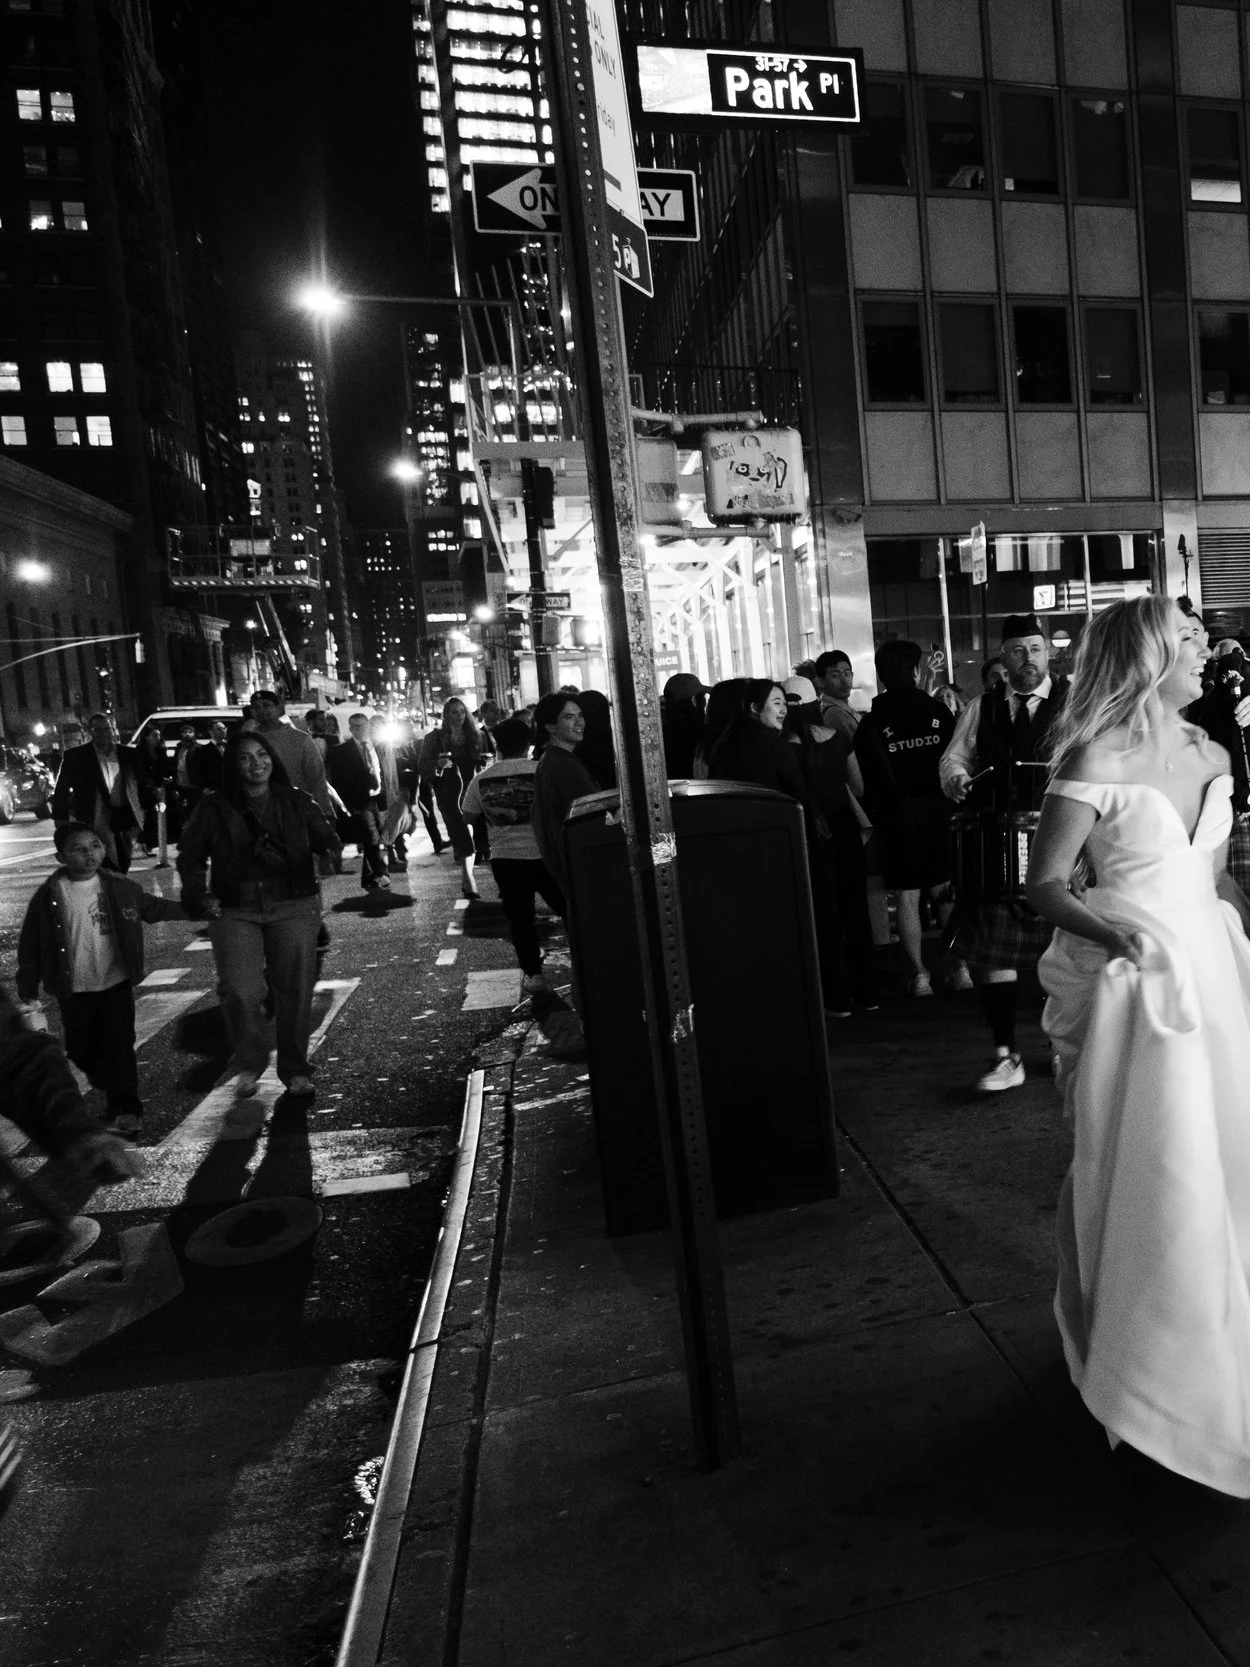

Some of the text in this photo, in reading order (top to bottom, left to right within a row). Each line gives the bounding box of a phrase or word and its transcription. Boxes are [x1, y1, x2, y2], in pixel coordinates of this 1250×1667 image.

[755, 57, 790, 72] 31-57
[725, 66, 839, 111] Park Pl
[519, 185, 672, 217] ON AY
[888, 734, 941, 753] STUDIO
